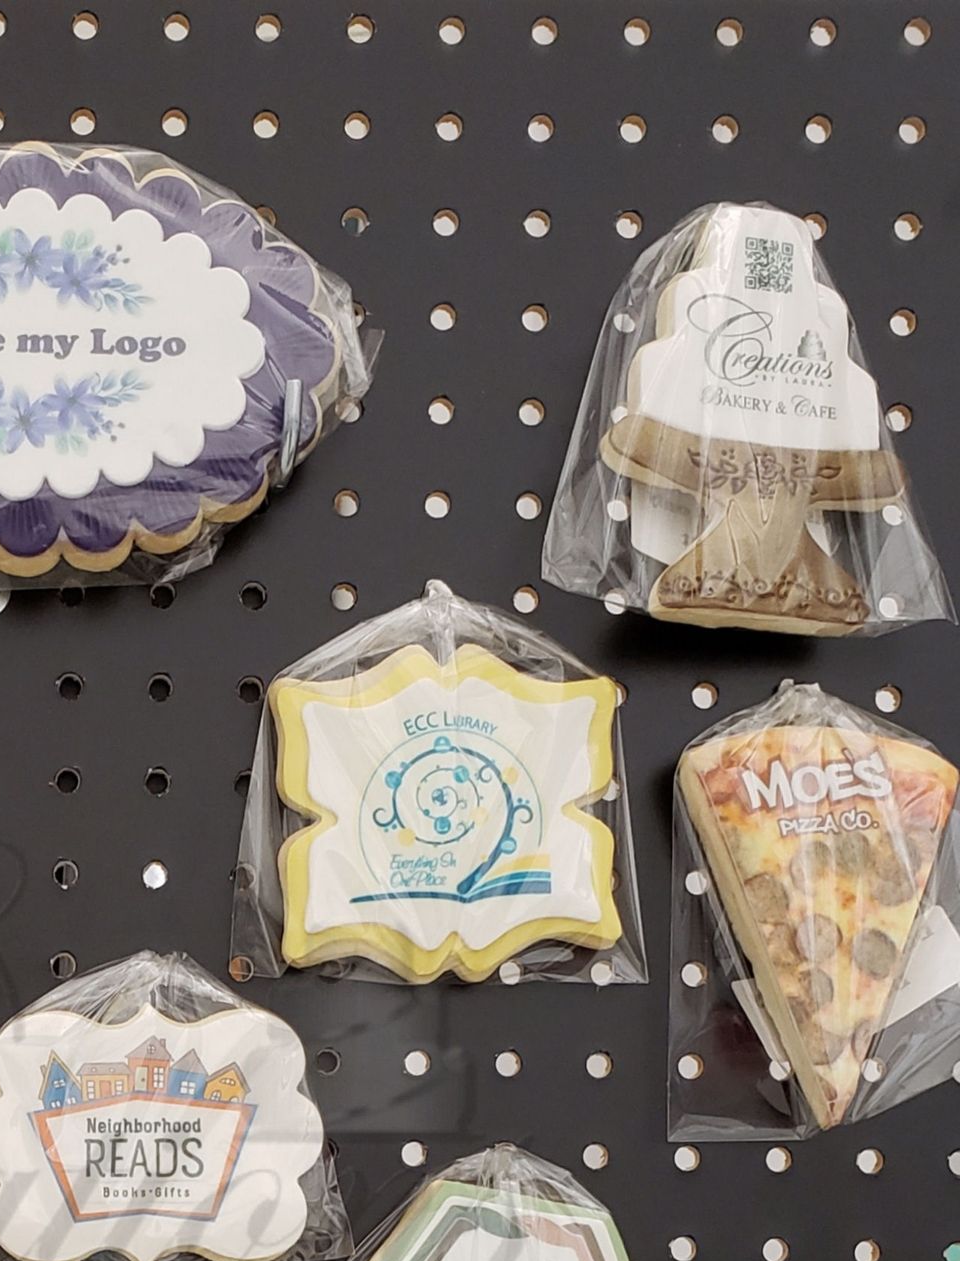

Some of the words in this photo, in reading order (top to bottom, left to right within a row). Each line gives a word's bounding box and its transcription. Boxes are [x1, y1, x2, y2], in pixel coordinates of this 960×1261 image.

[15, 333, 79, 360] my
[90, 328, 187, 363] Logo
[687, 293, 834, 387] Creations
[700, 387, 772, 413] BAKERY
[775, 401, 787, 415] &
[791, 394, 838, 420] CAFE
[403, 711, 439, 736] ECC
[777, 812, 840, 838] PIZZA
[86, 1117, 202, 1137] Neighborhood
[84, 1137, 205, 1178] READS
